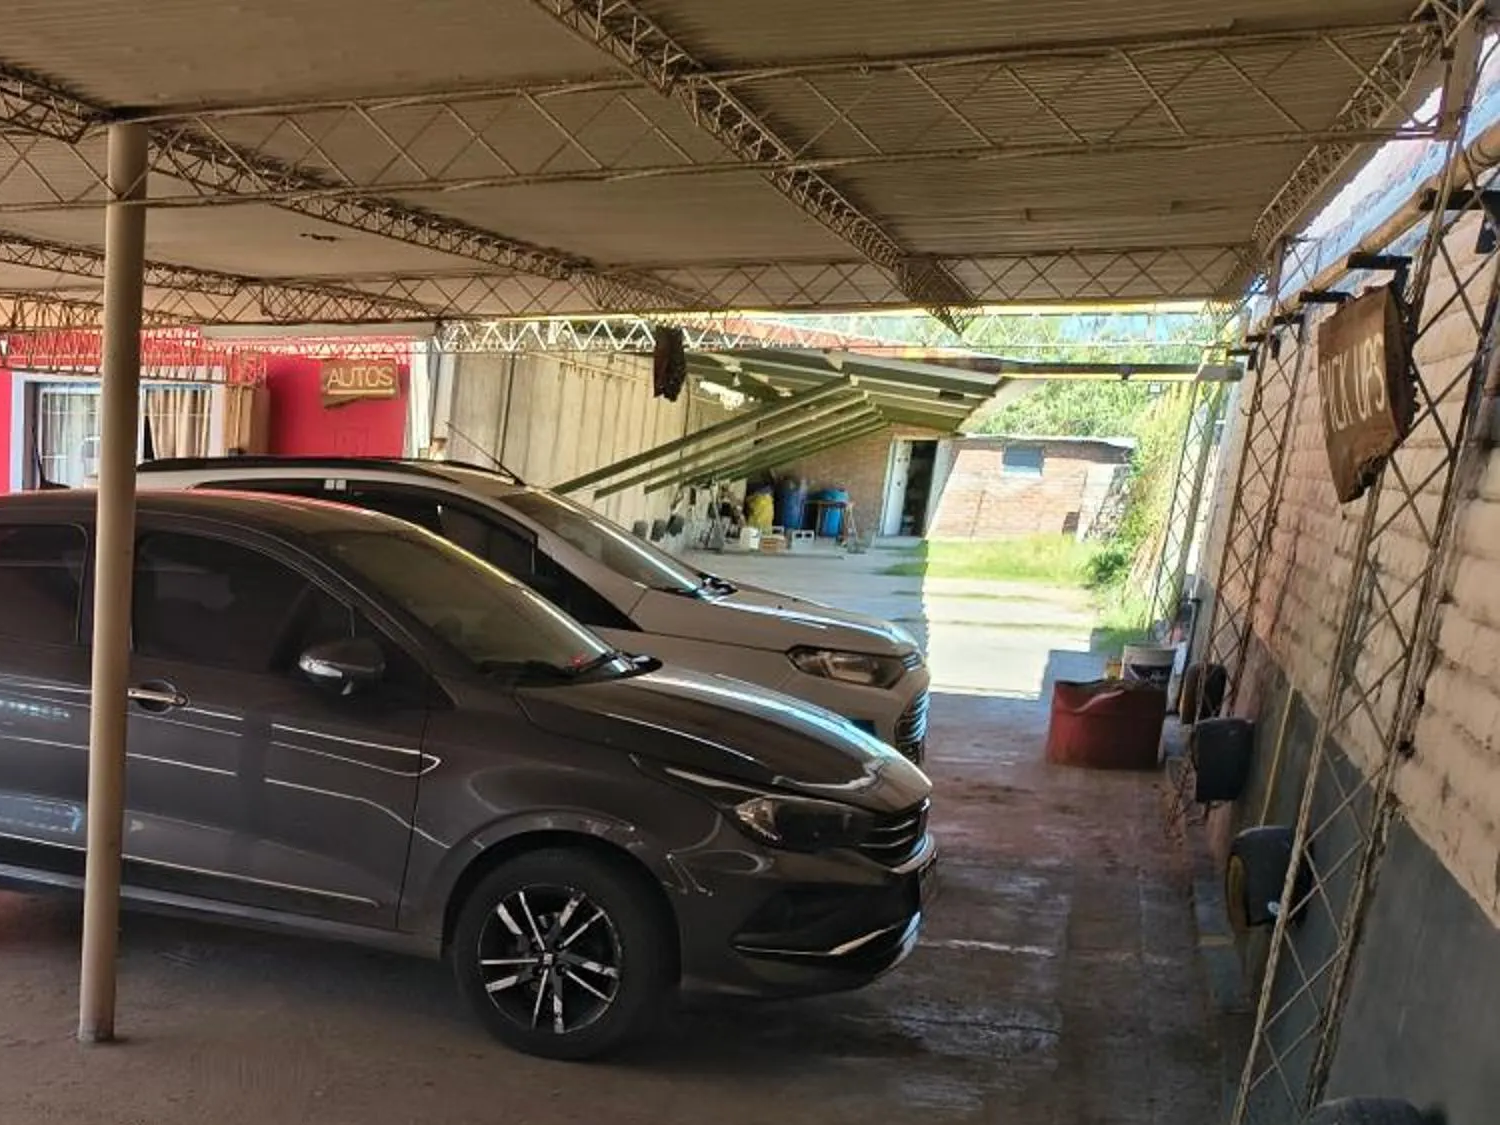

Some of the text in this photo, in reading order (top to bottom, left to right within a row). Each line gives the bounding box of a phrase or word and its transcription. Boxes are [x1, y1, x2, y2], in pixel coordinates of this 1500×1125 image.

[326, 366, 393, 388] AUTOS
[1320, 332, 1385, 436] PICK UPS
